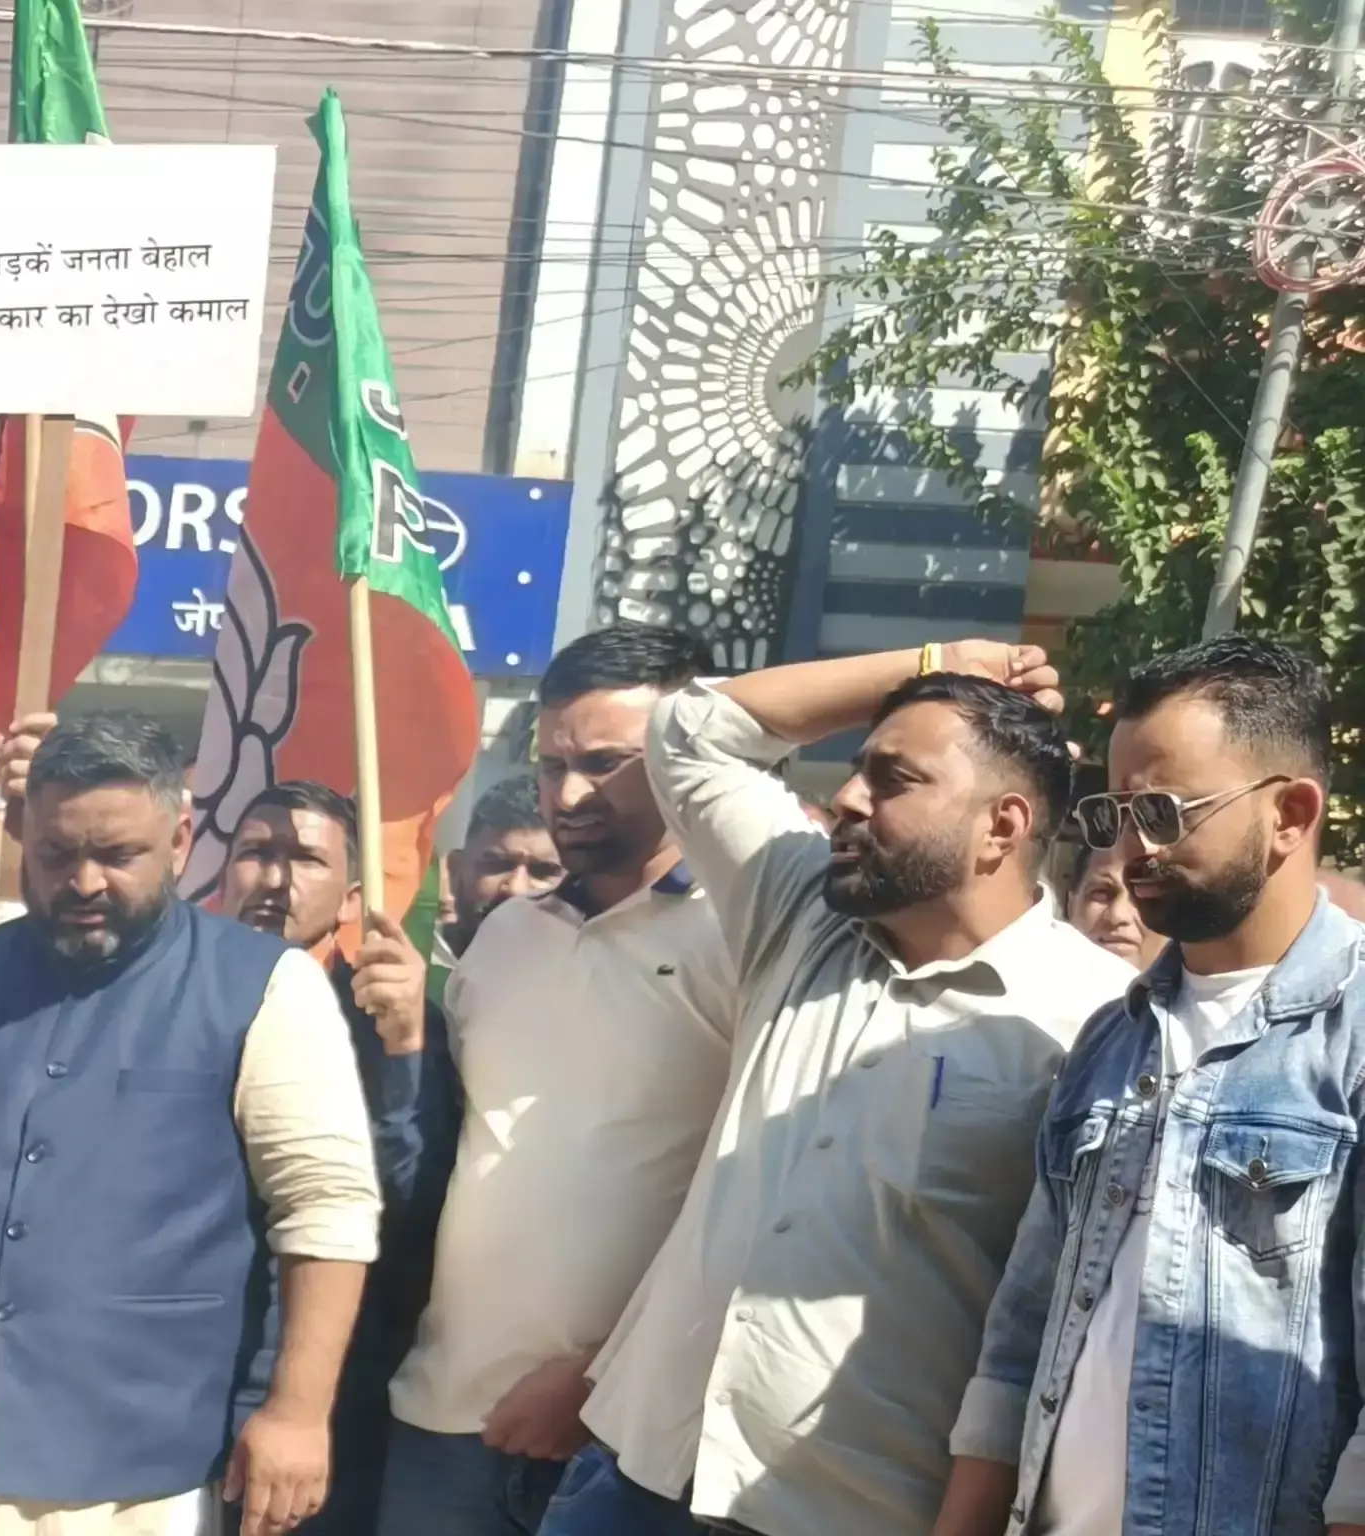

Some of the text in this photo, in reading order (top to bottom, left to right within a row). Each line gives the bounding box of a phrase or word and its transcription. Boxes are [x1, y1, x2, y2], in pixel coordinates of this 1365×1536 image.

[61, 248, 132, 272] जनता
[140, 237, 212, 271] बेहाल
[55, 304, 93, 328] का
[101, 293, 158, 329] देखो
[167, 299, 249, 324] कमाल
